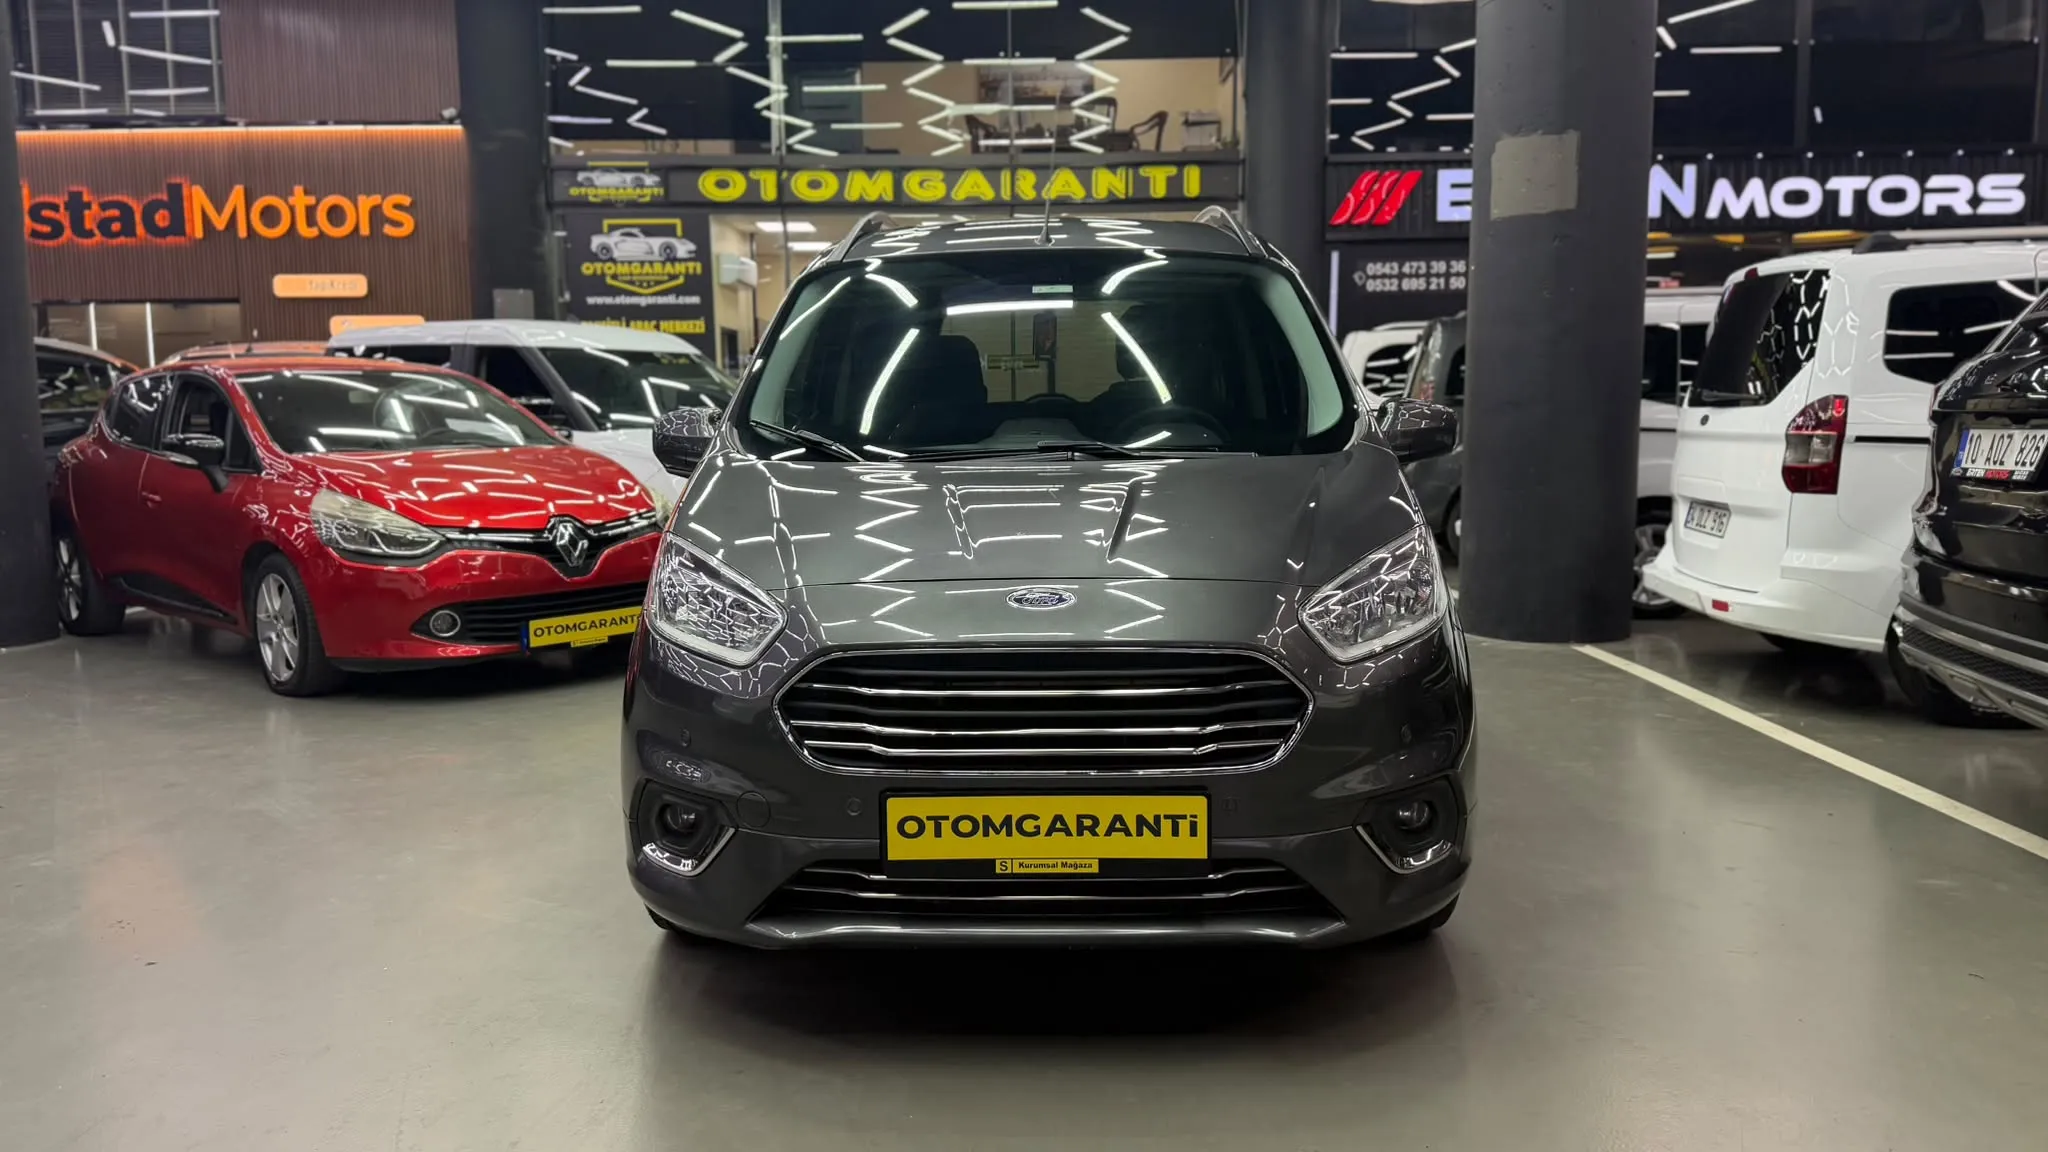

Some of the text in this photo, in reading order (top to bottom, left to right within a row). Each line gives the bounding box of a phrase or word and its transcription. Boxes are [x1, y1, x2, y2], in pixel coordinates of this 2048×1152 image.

[698, 165, 1201, 201] OTOMGARANTI
[1704, 173, 2027, 219] MOTORS
[580, 262, 702, 275] OTOMGARANTI
[1429, 276, 1445, 290] 21
[1966, 432, 2046, 467] 10 AOZ 826
[1018, 861, 1058, 869] Kurumsal
[1061, 861, 1093, 871] Mağaza
